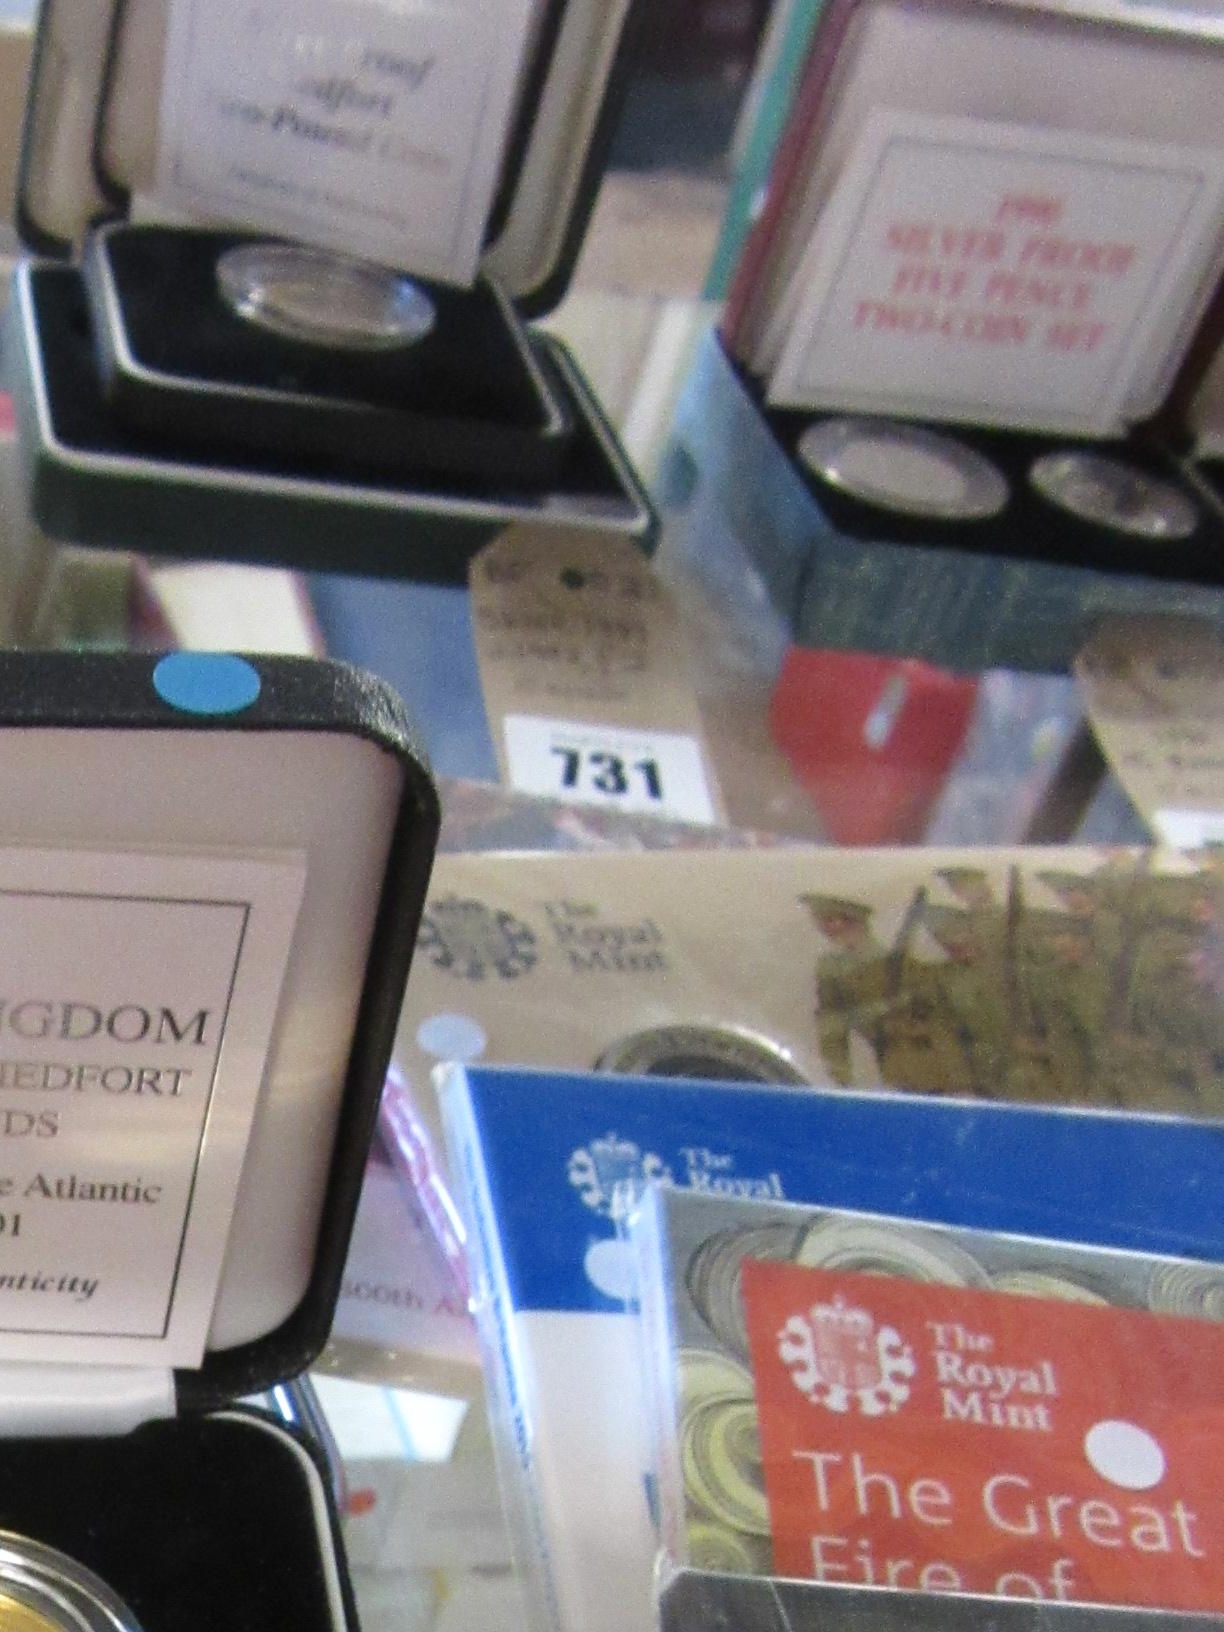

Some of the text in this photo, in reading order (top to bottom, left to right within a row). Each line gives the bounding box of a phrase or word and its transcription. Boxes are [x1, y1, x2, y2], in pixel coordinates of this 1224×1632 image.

[551, 746, 664, 802] 731
[680, 1146, 734, 1170] The
[23, 1169, 164, 1206] Atlantic
[925, 1319, 995, 1352] The
[935, 1348, 1059, 1400] Royal
[941, 1388, 1055, 1434] Mint
[791, 1447, 1208, 1560] The Great
[810, 1533, 963, 1594] Fire
